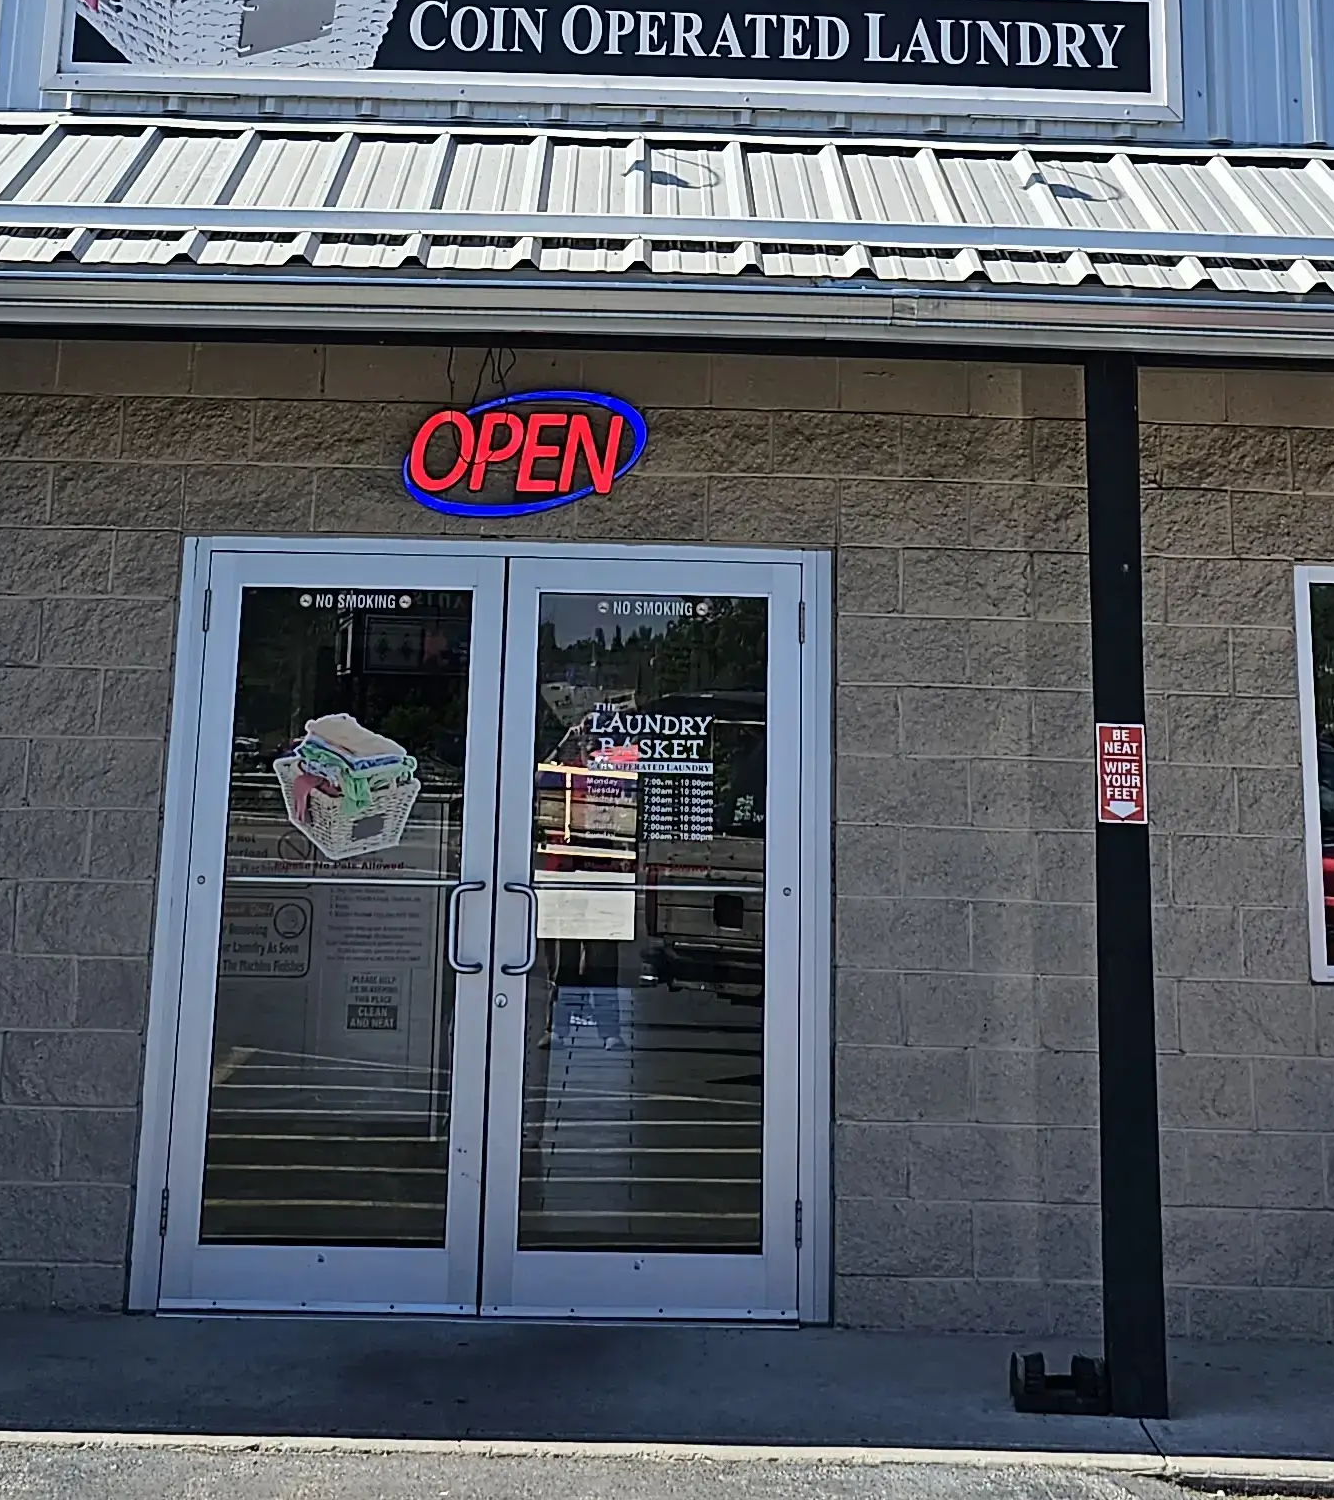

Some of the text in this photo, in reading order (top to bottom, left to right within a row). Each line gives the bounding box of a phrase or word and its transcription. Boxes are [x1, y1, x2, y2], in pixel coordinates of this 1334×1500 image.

[409, 0, 1126, 70] COIN OPERATED LAUNDRY
[409, 409, 625, 495] OPEN
[315, 593, 334, 608] NO
[337, 593, 396, 610] SMOKING
[613, 600, 693, 616] NO SMOKING
[590, 711, 713, 736] LAUNDRY
[1112, 729, 1130, 741] BE
[598, 736, 704, 759] BASKET
[1104, 742, 1139, 754] NEAT
[666, 763, 710, 772] LAUNDRY
[1104, 761, 1140, 774] WIPE
[587, 777, 618, 786] Monday
[1103, 774, 1140, 787] YOUR
[587, 786, 621, 796] Tuesday
[1106, 787, 1139, 800] FEET
[233, 941, 265, 957] Laundry
[358, 1006, 388, 1017] CLEAN
[350, 1018, 395, 1029] AND NEAT
